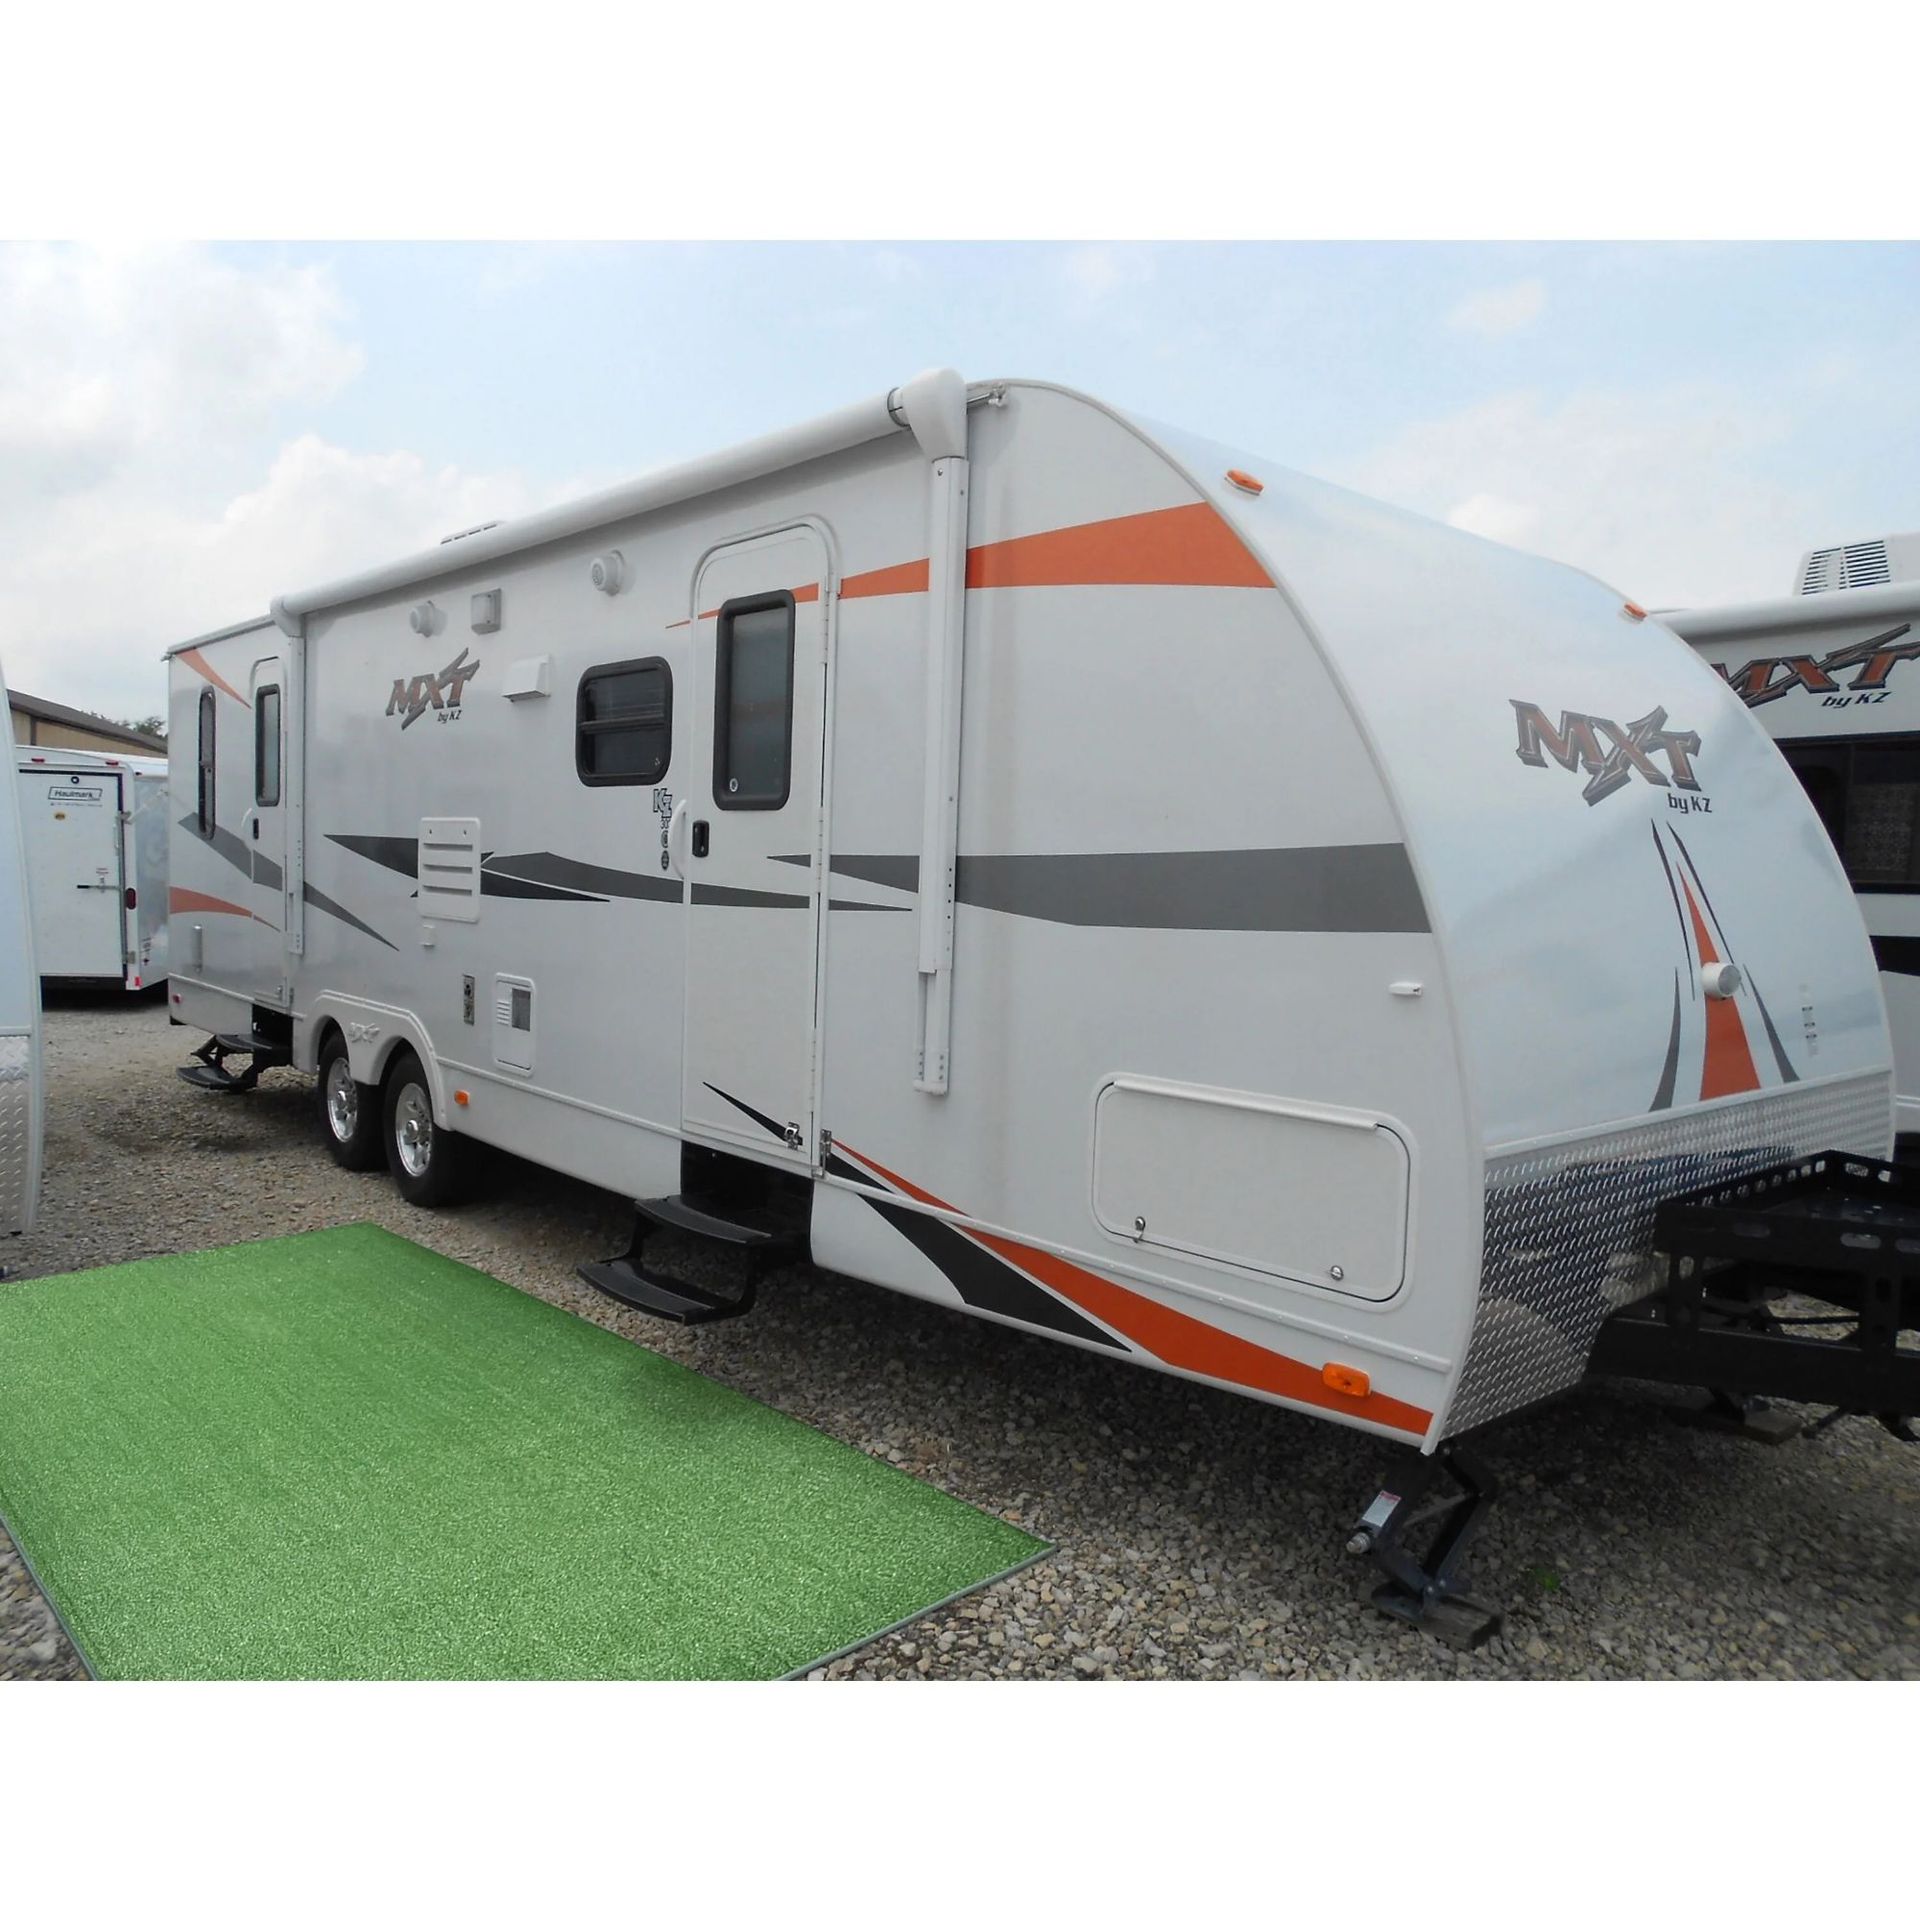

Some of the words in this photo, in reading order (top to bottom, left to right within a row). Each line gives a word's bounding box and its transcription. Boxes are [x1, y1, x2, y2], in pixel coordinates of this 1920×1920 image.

[385, 647, 480, 731] MXT
[1821, 695, 1852, 708] by
[1854, 691, 1891, 705] KZ
[437, 712, 450, 724] by
[449, 709, 462, 721] KZ
[1509, 699, 1702, 807] MXT
[1667, 793, 1689, 814] by
[1690, 796, 1713, 813] KZ
